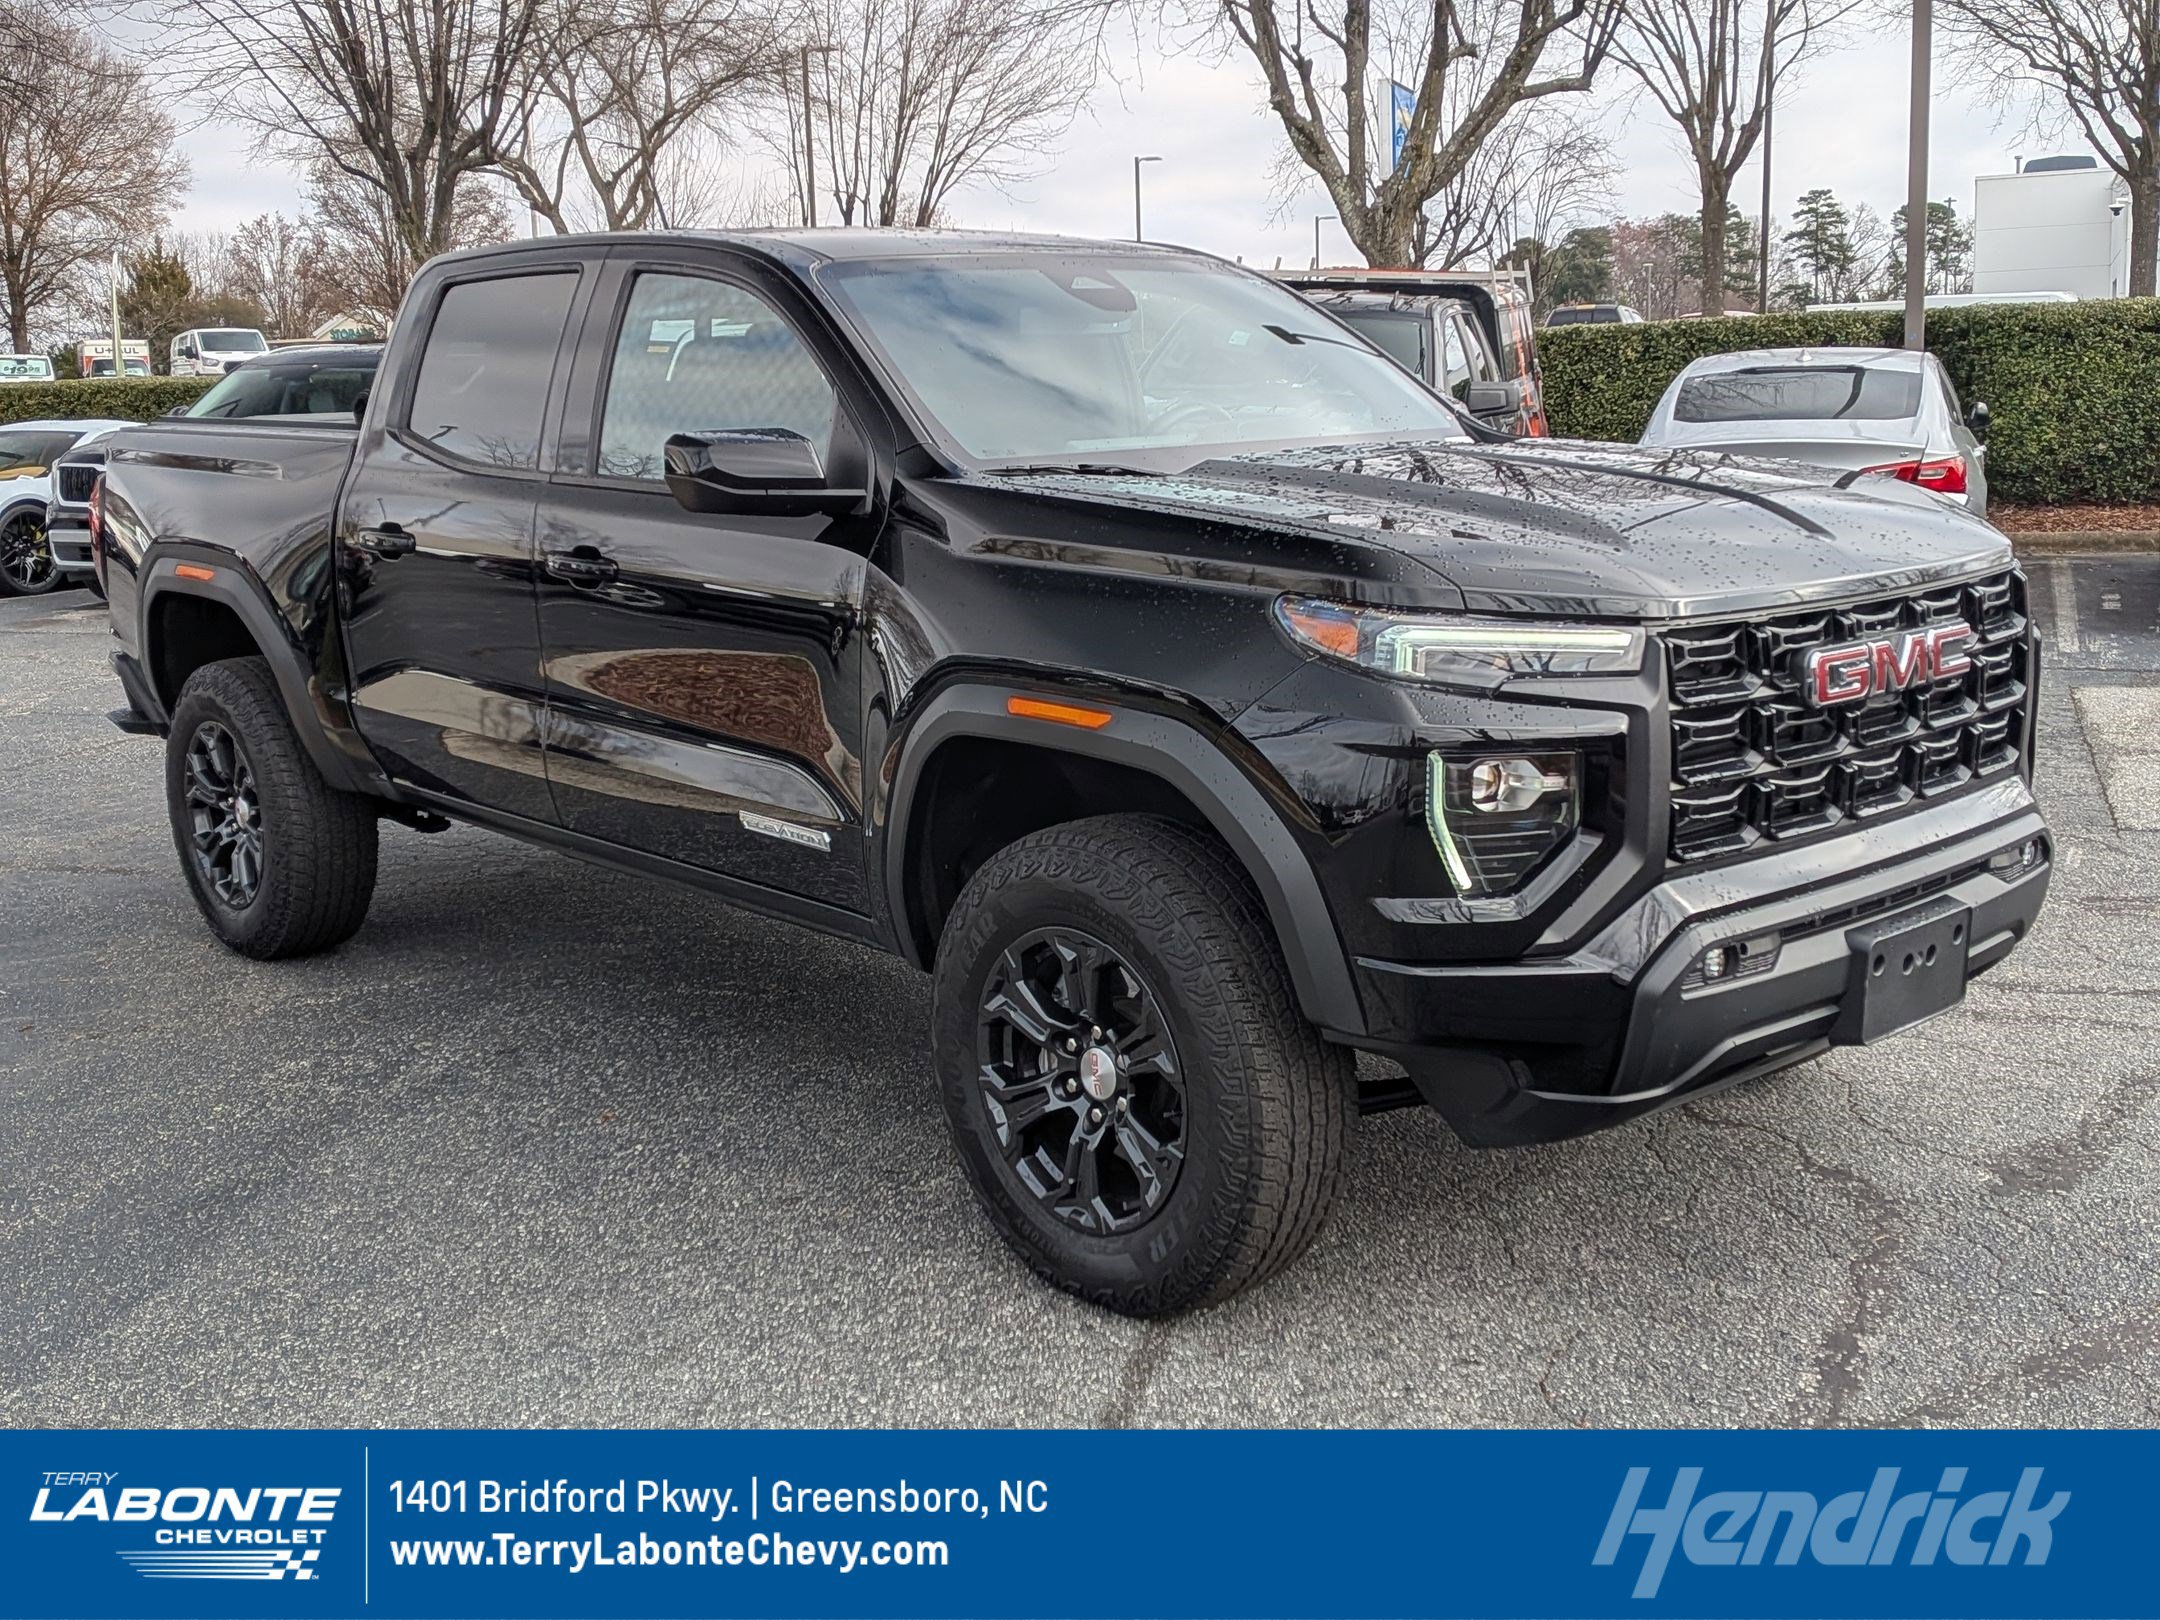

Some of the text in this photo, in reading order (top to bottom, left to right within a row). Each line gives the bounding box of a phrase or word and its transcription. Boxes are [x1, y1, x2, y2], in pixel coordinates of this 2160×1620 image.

[329, 327, 374, 341] STORA
[1811, 621, 1972, 707] GMC
[1088, 1049, 1104, 1096] GMC
